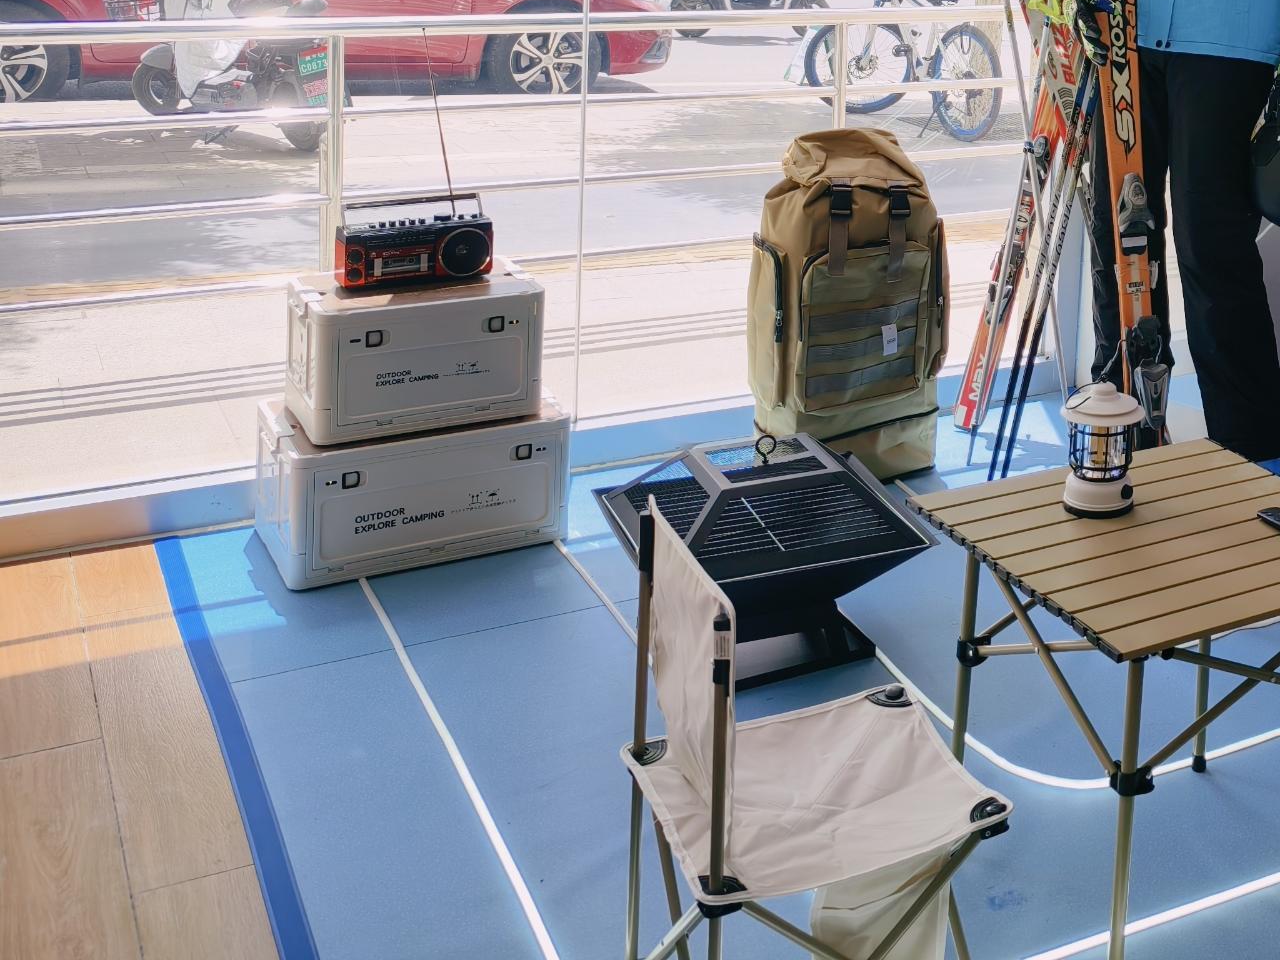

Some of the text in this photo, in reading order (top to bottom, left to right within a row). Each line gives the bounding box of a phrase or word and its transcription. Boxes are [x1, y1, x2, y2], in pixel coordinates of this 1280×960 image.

[375, 373, 439, 387] EXPLORE CAMPING
[376, 369, 412, 380] OUTDOOR
[354, 507, 406, 524] OUTDOOR
[354, 510, 445, 534] EXPLORE CAMPING
